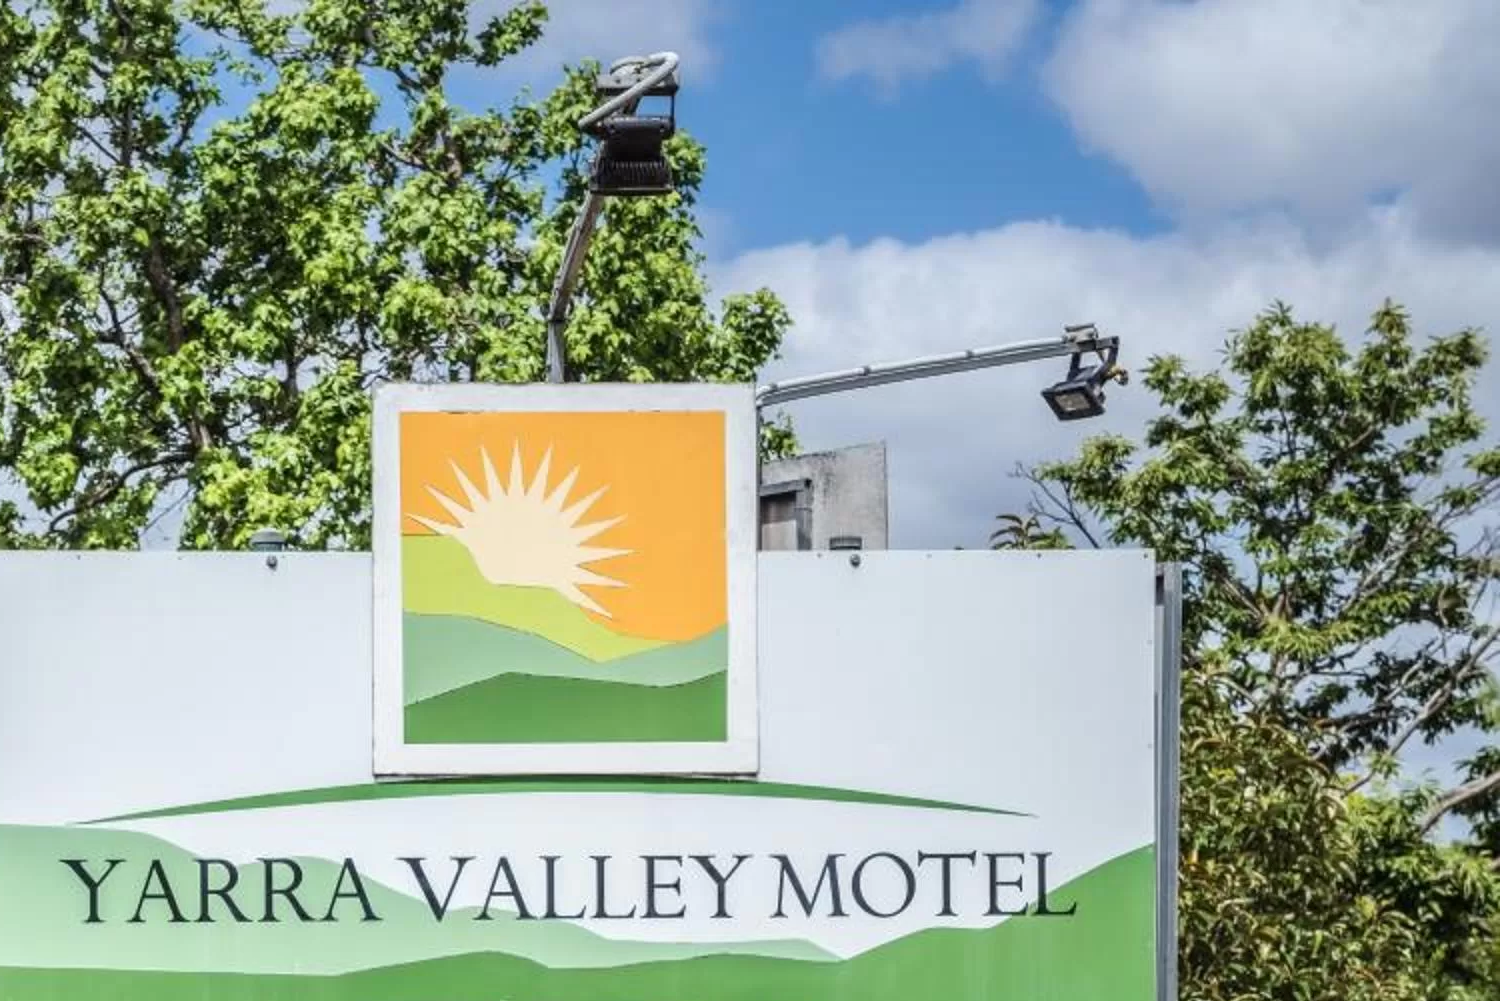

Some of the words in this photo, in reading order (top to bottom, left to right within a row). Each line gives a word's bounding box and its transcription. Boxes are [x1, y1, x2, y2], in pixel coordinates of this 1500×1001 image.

[59, 857, 383, 925] YARRA
[399, 855, 755, 923] VALLEY
[771, 850, 1080, 921] MOTEL
